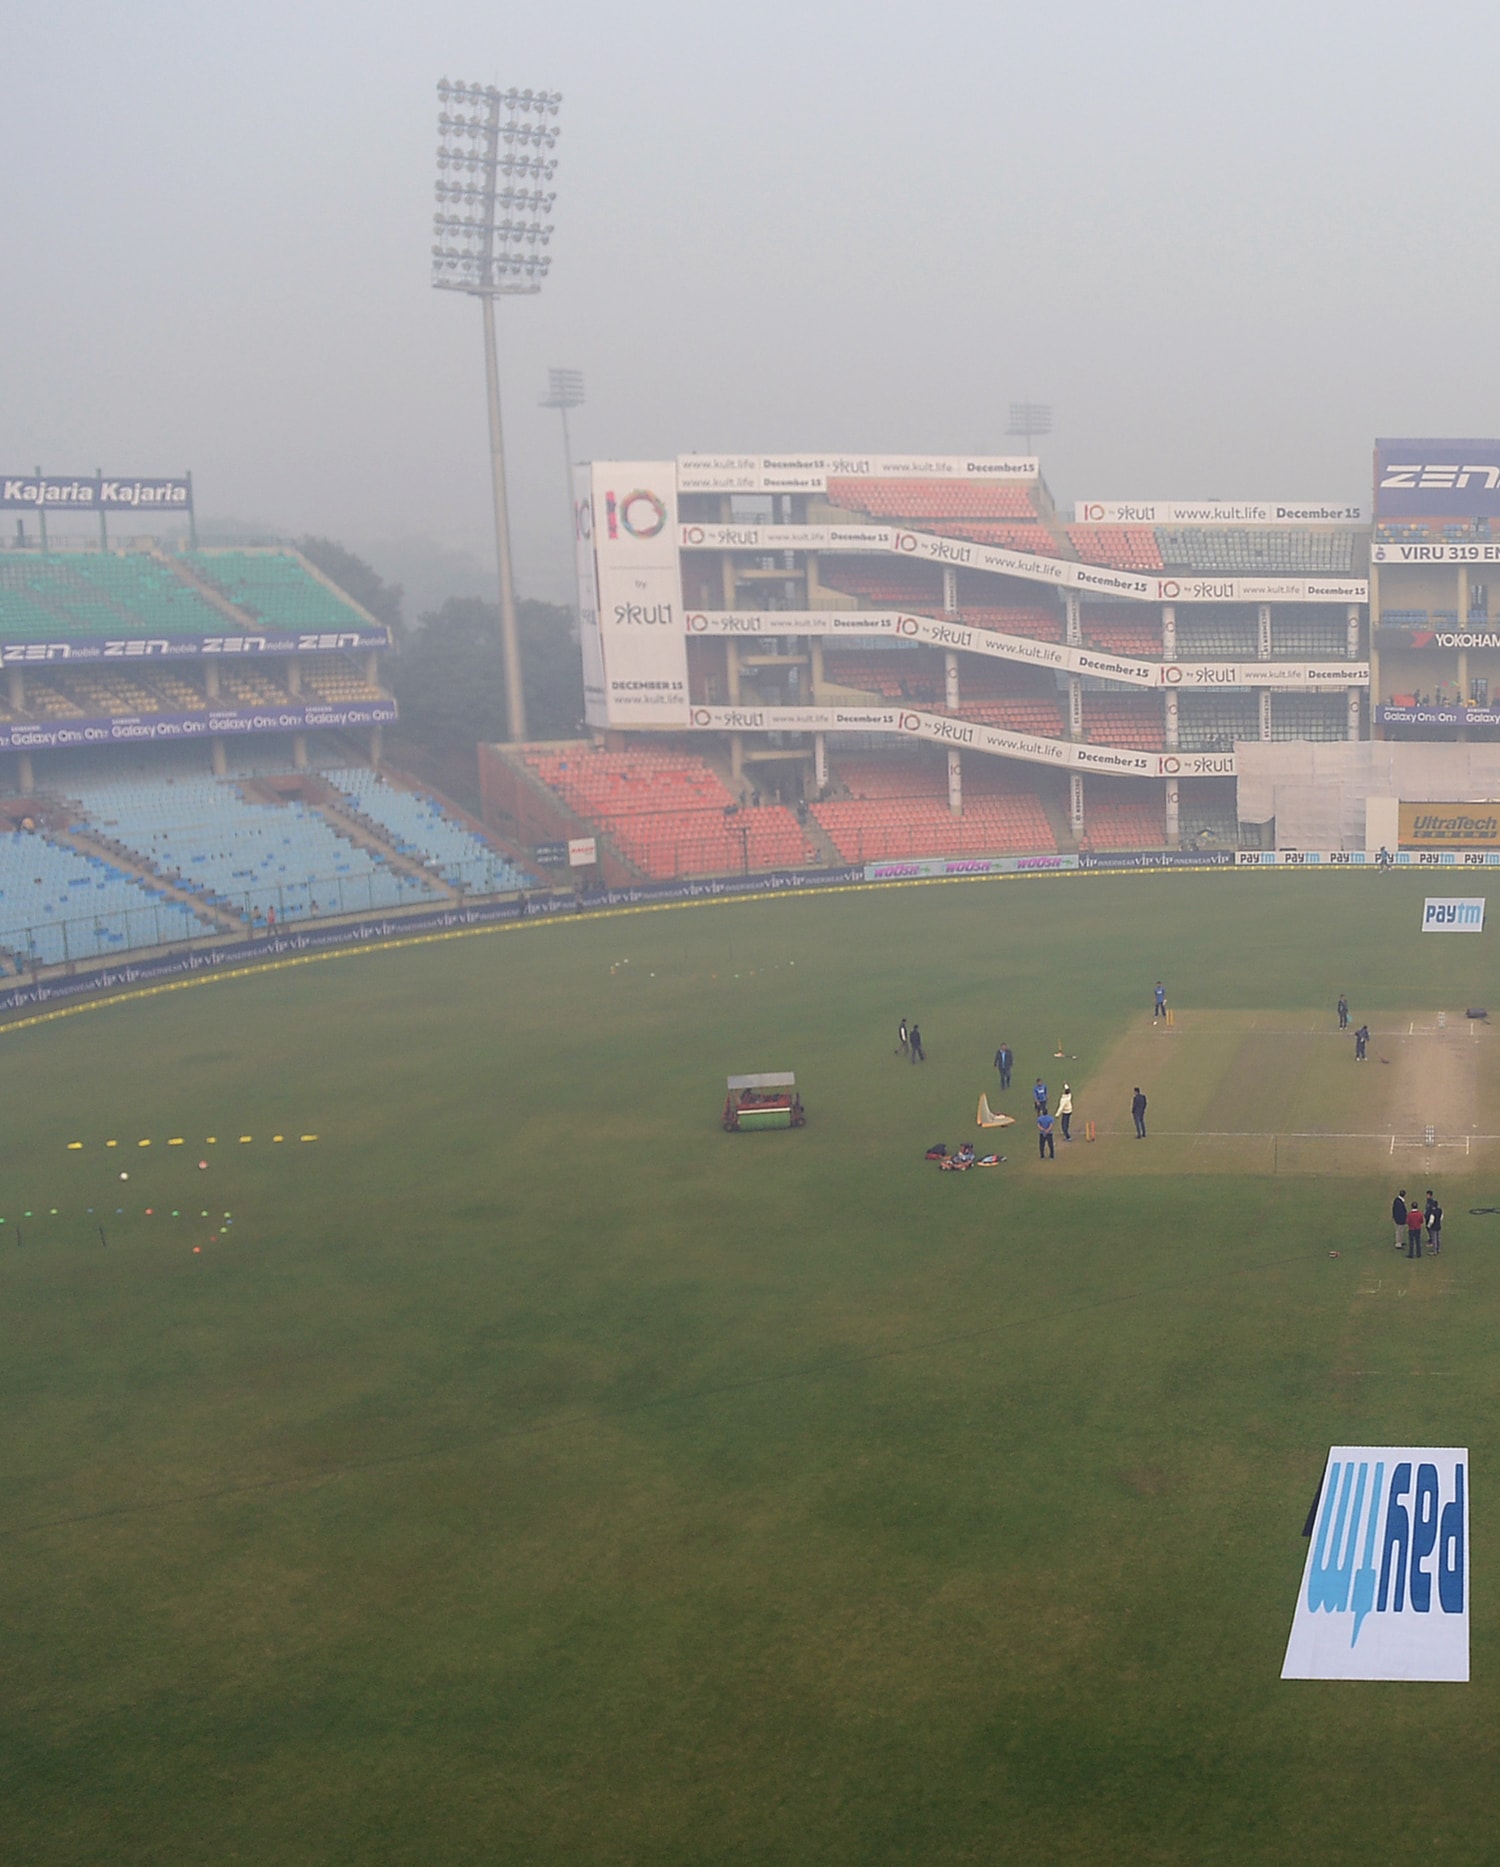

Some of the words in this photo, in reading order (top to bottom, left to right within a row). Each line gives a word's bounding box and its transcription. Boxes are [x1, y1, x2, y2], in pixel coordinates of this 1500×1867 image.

[3, 480, 93, 505] Kajaria
[101, 482, 187, 506] Kajaria
[1174, 506, 1266, 520] www.kult.life
[1276, 507, 1342, 519] December
[1345, 508, 1360, 519] 15
[1400, 546, 1444, 560] VIRU
[1449, 546, 1479, 560] 319
[831, 532, 876, 541] December
[985, 553, 1062, 577] www.kult.life
[1077, 570, 1133, 590] December
[1134, 581, 1147, 592] 15
[1308, 586, 1353, 595] December
[1355, 586, 1366, 595] 15
[833, 619, 878, 628] December
[985, 638, 1062, 662] www.kult.life
[1079, 656, 1134, 676] December
[1136, 667, 1149, 678] 15
[612, 681, 670, 691] DECEMBER
[672, 681, 683, 690] 15
[1384, 712, 1417, 723] Galaxy
[1466, 713, 1500, 724] Galaxy
[837, 714, 881, 723] December
[987, 734, 1063, 758] www.kult.life
[1077, 750, 1132, 767] December
[1134, 757, 1147, 769] 15
[1413, 815, 1497, 830] UltraTech
[1240, 852, 1275, 864] paytm
[1285, 852, 1320, 864] paytm
[1330, 852, 1365, 864] paytm
[1420, 852, 1455, 864] paytm
[1465, 852, 1499, 864] paytm
[1426, 902, 1481, 923] paytm
[1307, 1462, 1464, 1648] paytm
